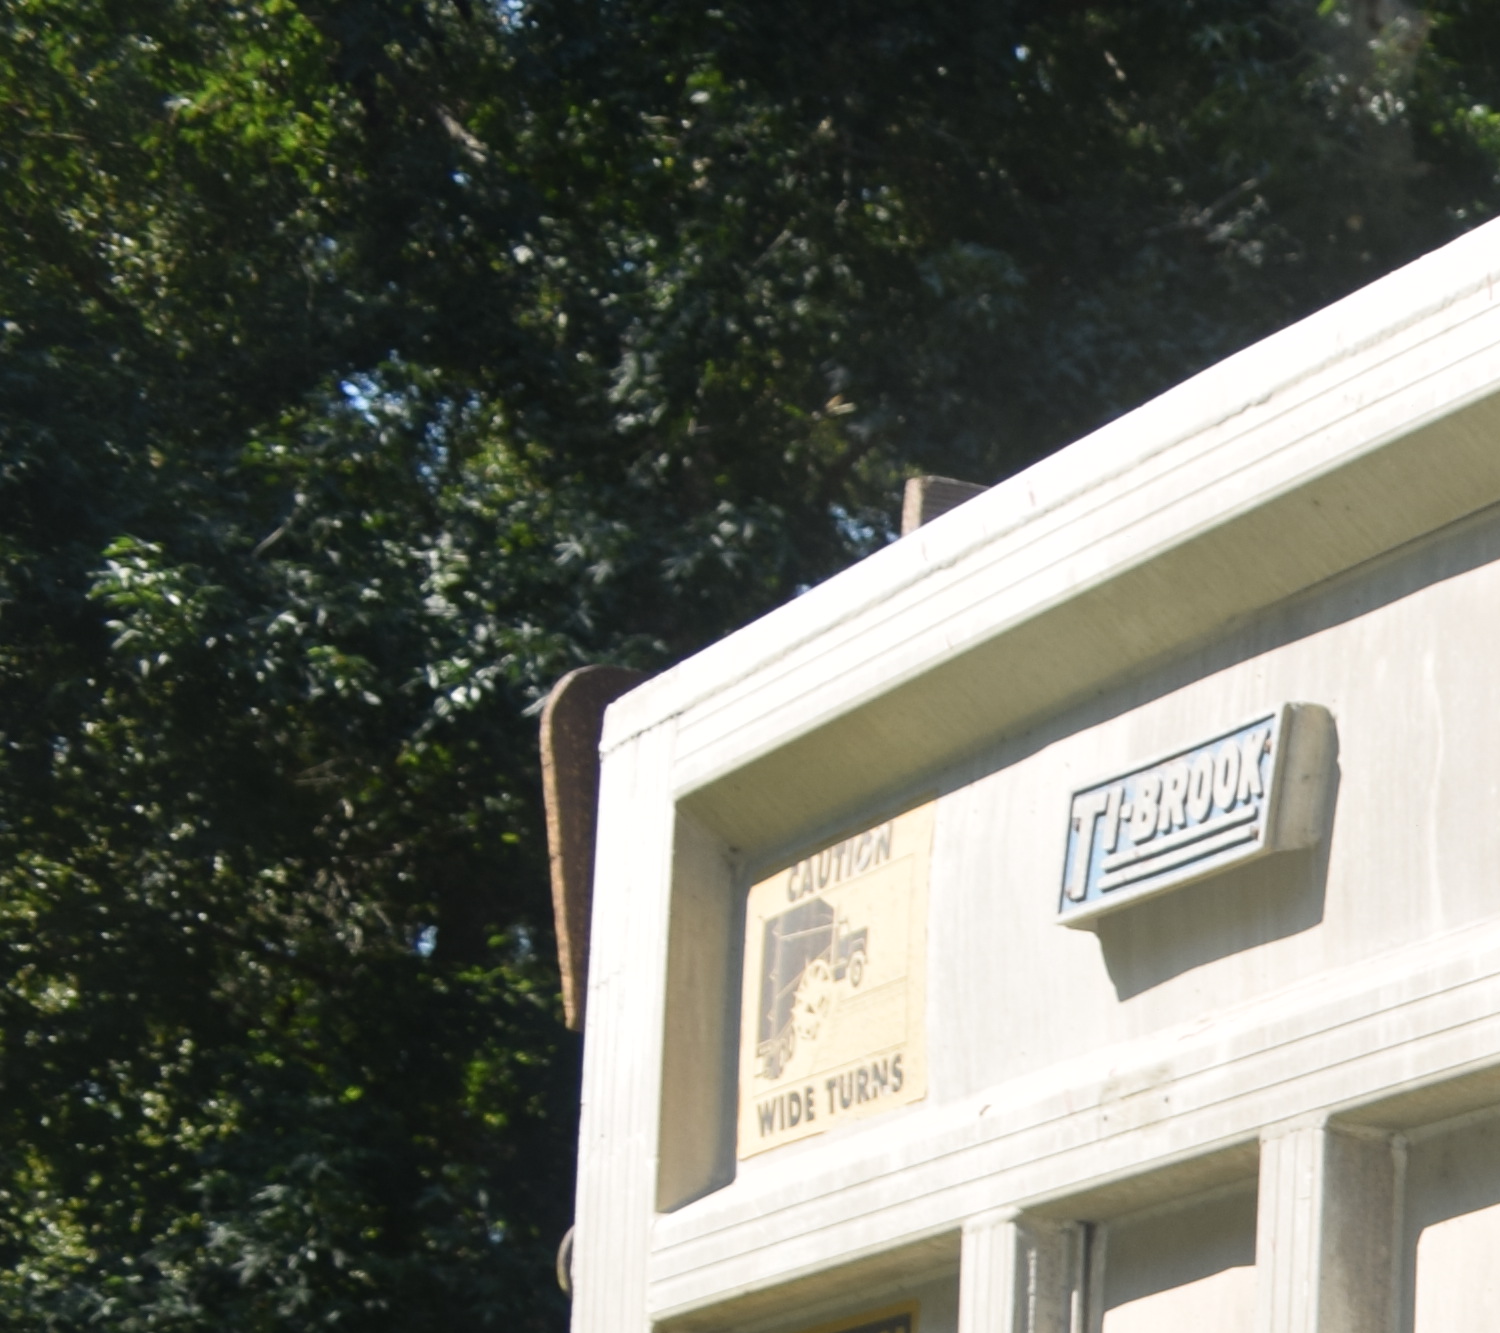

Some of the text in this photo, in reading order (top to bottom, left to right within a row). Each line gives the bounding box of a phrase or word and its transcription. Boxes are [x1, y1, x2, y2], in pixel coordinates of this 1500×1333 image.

[1066, 727, 1271, 901] TI-BROOK
[788, 819, 893, 902] CAUTION
[757, 1052, 904, 1137] WIDE TURNS
